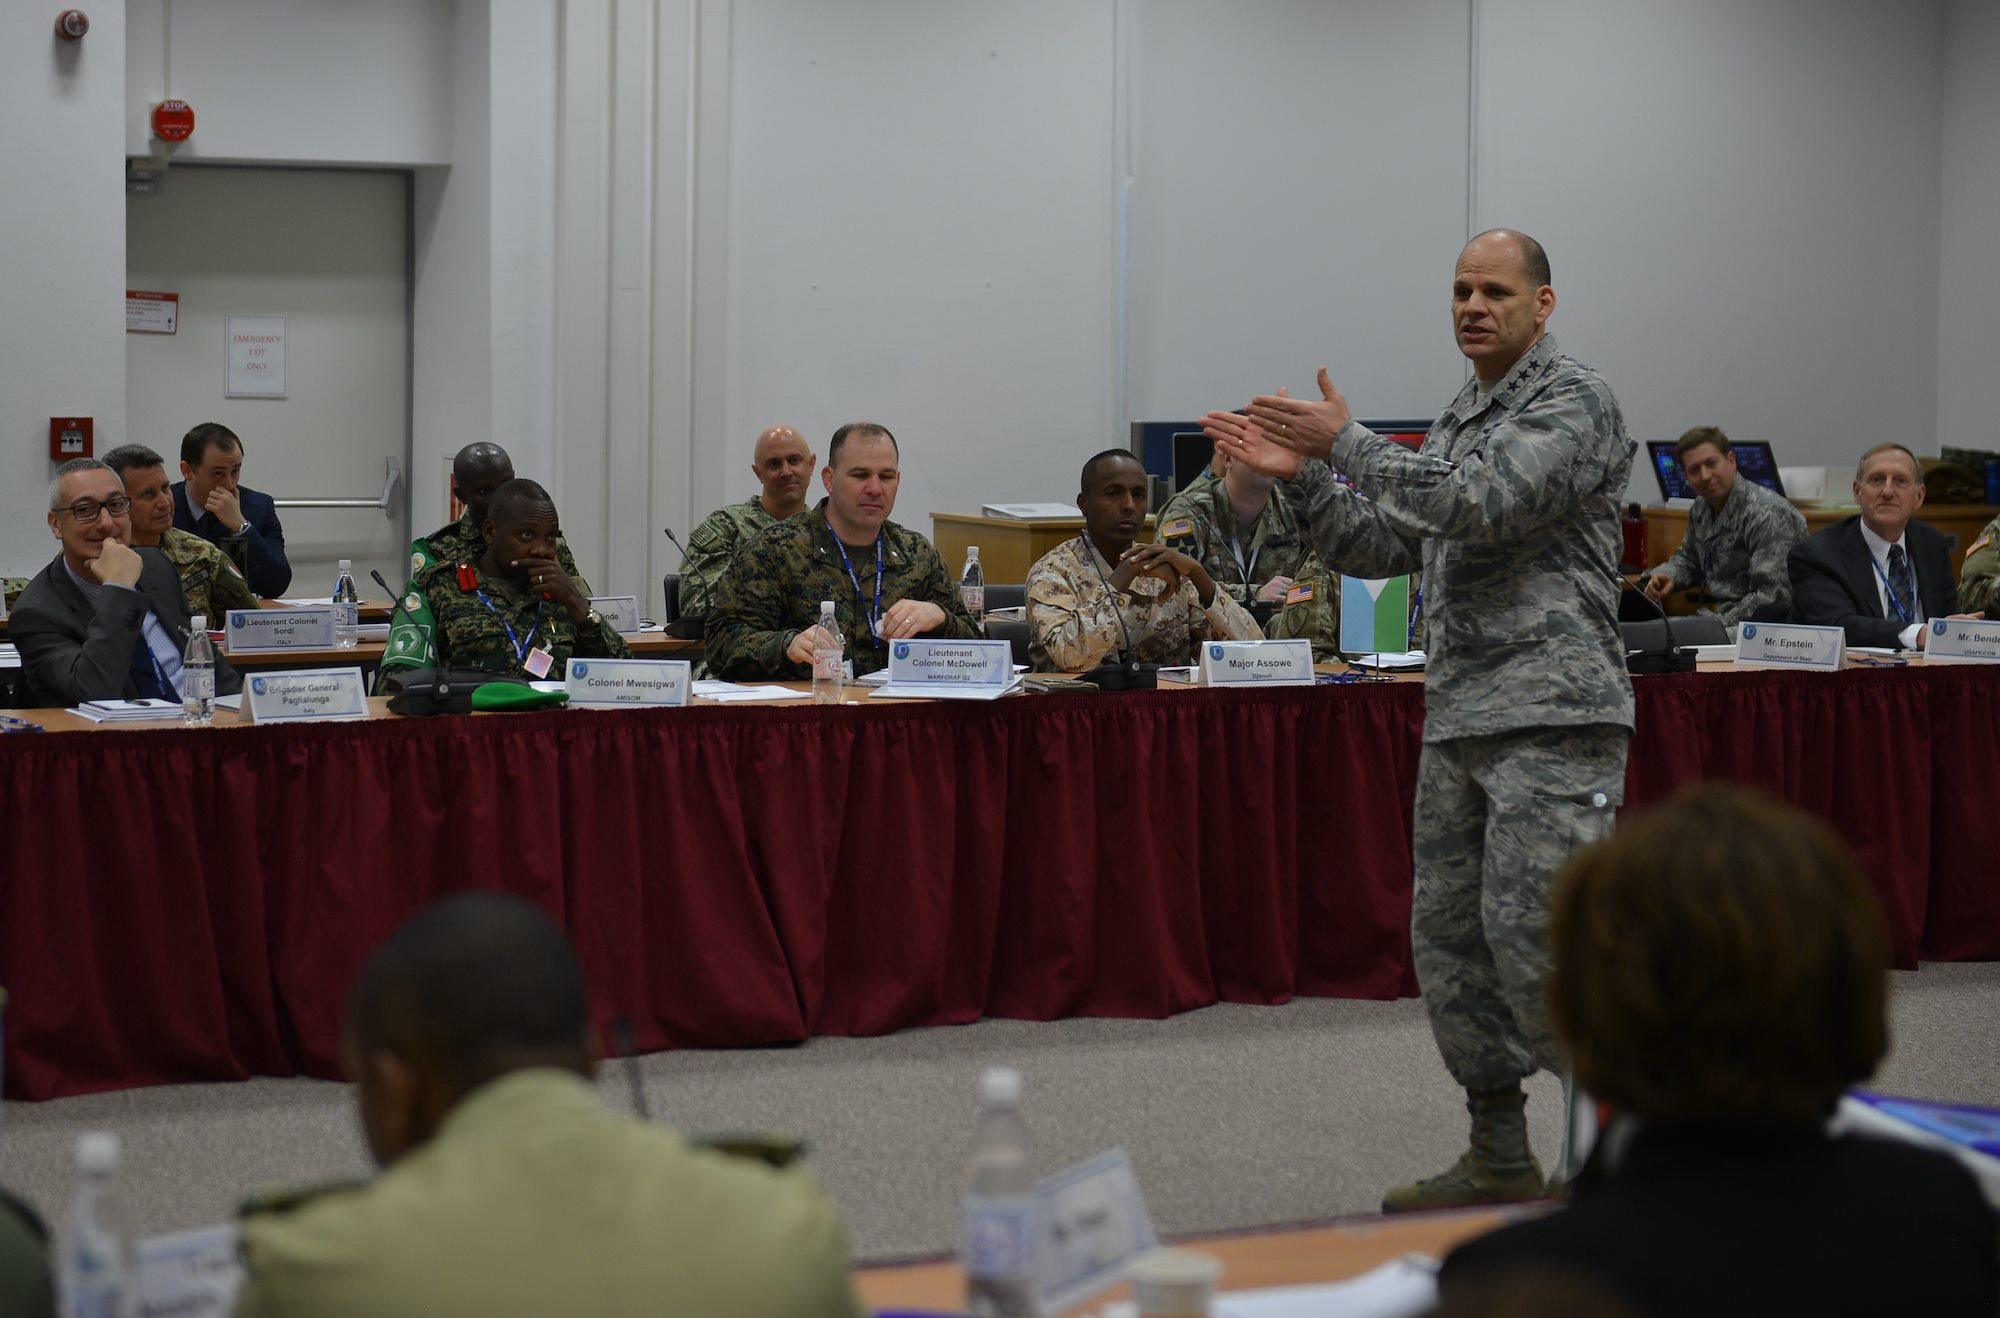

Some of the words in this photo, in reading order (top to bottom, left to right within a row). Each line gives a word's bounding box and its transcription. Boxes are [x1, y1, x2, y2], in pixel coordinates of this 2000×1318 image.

[233, 335, 281, 343] EMERGENCY
[249, 348, 265, 356] EXIT
[246, 362, 268, 370] ONLY
[246, 618, 287, 626] Lieutenant
[288, 617, 318, 625] Colonel
[273, 627, 295, 635] Sordi
[1957, 633, 1971, 641] Mr.
[1764, 637, 1778, 647] Mr.
[1780, 638, 1814, 649] Epstein
[928, 648, 973, 657] Lieutenant
[912, 659, 945, 667] Colonel
[946, 660, 987, 668] McDowell
[1229, 660, 1254, 669] Major
[1256, 659, 1292, 667] Assowe
[587, 678, 624, 687] Colonel
[626, 679, 675, 690] Mwesigwa
[268, 685, 306, 696] Brigadier
[308, 683, 339, 692] General
[282, 696, 330, 706] Paglialunga
